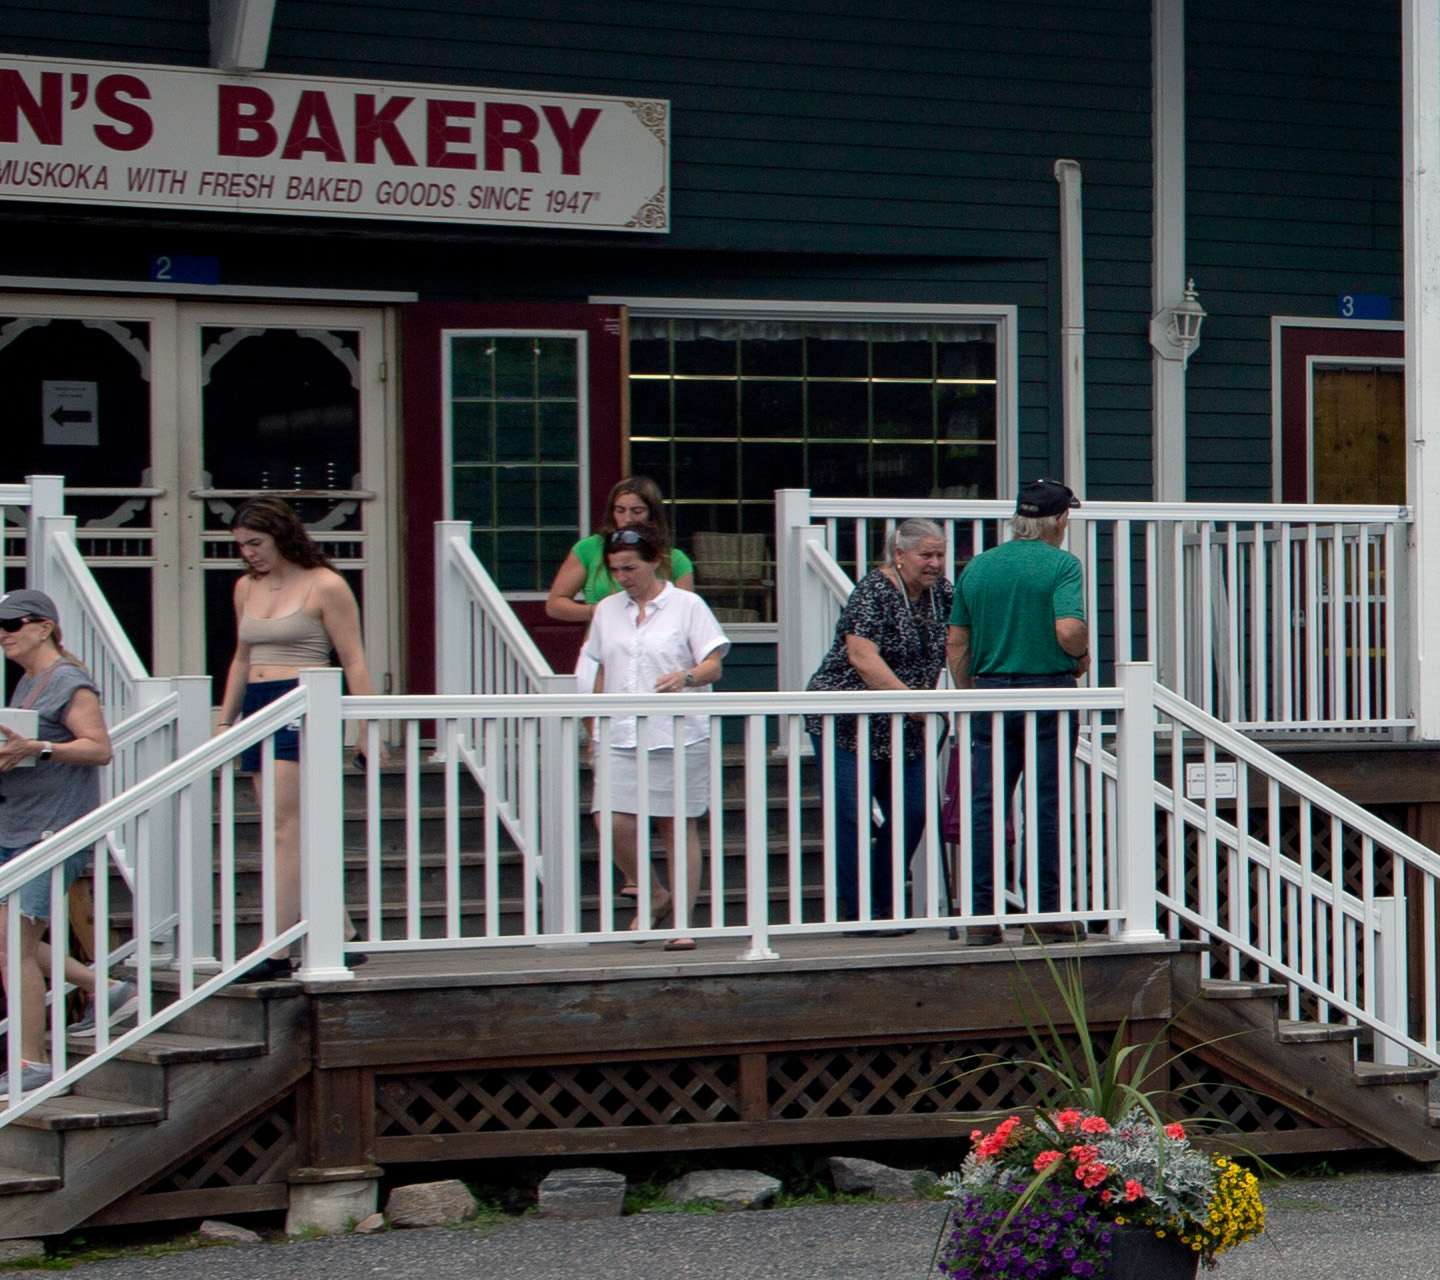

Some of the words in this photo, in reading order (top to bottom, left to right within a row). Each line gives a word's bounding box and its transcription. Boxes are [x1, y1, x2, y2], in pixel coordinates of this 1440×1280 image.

[217, 84, 603, 176] BAKERY
[127, 167, 187, 195] WITH
[198, 171, 275, 199] FRESH
[286, 176, 363, 204] BAKED
[468, 185, 534, 212] SINCE
[156, 255, 172, 280] 2
[1342, 295, 1354, 317] 3
